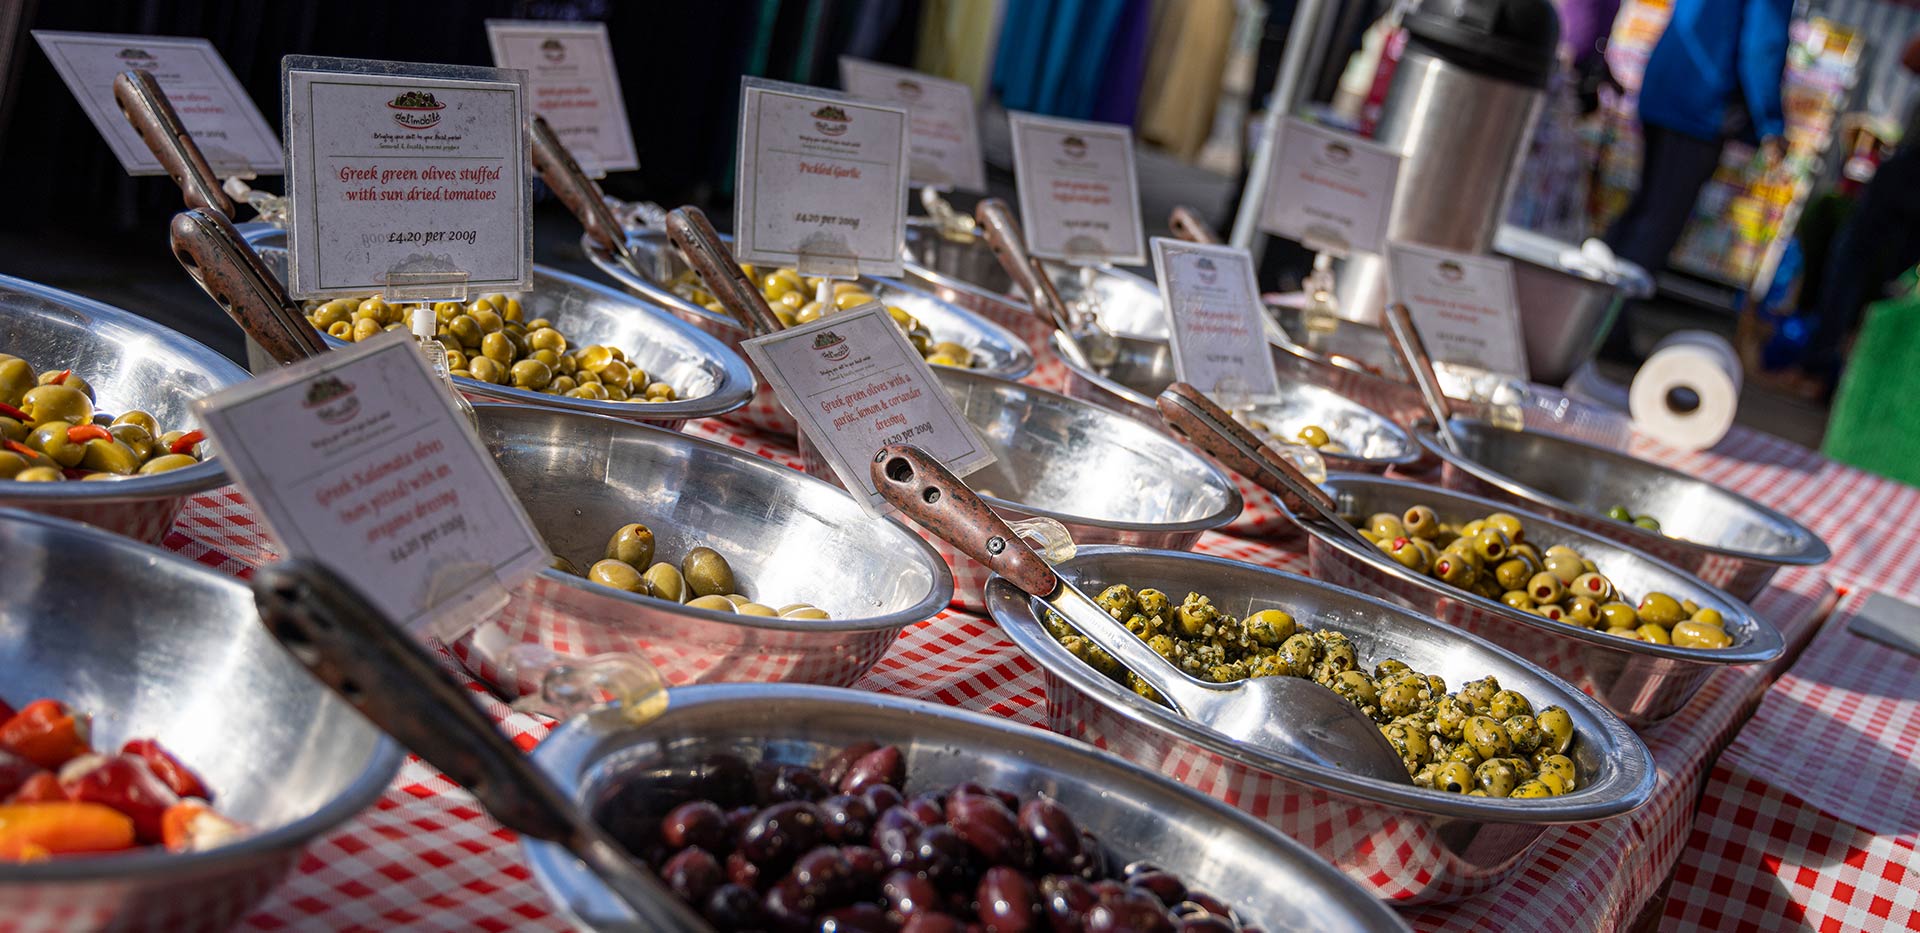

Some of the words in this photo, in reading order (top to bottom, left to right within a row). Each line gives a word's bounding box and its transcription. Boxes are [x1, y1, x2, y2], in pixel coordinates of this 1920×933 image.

[340, 164, 379, 183] Greek
[380, 167, 419, 185] green
[421, 165, 457, 181] olives
[459, 165, 503, 185] stuffed
[799, 160, 833, 177] Pickled
[833, 165, 862, 180] Garlic
[345, 186, 377, 201] with
[380, 189, 404, 201] sun
[407, 186, 443, 201] dried
[443, 188, 497, 201] tomatoes
[388, 231, 422, 243] £4.20
[422, 230, 446, 247] per
[448, 230, 477, 245] 200g
[820, 394, 846, 414] Greek
[844, 389, 868, 408] green
[866, 382, 889, 397] olives
[886, 372, 906, 388] with
[904, 373, 912, 383] a
[833, 410, 860, 432] garlic,
[855, 402, 882, 419] lemon
[879, 399, 889, 410] &
[887, 386, 922, 407] coriander
[875, 412, 908, 431] dressing
[901, 428, 915, 443] per
[915, 421, 935, 434] 200g
